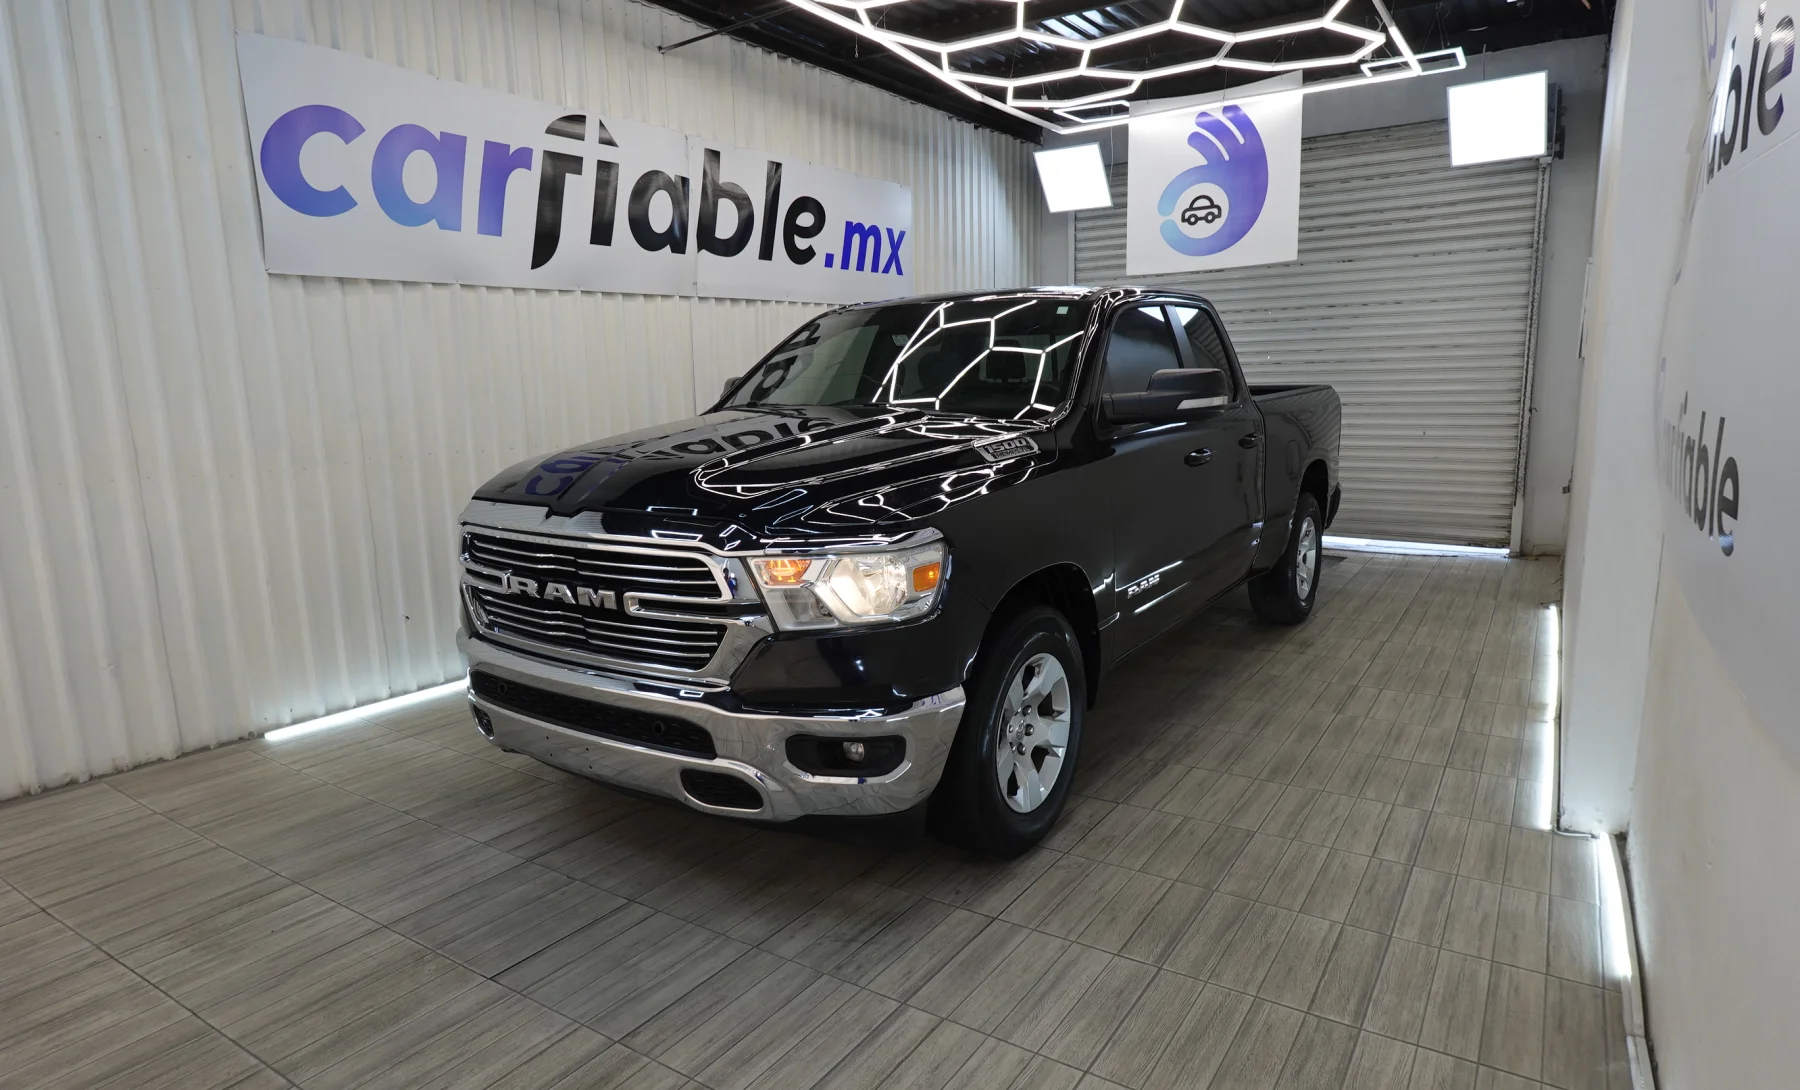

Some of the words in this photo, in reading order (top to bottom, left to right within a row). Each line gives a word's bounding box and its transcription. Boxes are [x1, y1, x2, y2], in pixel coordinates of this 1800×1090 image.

[260, 103, 907, 276] carfiable.mx
[984, 438, 1027, 453] 1500
[503, 571, 618, 610] RAM
